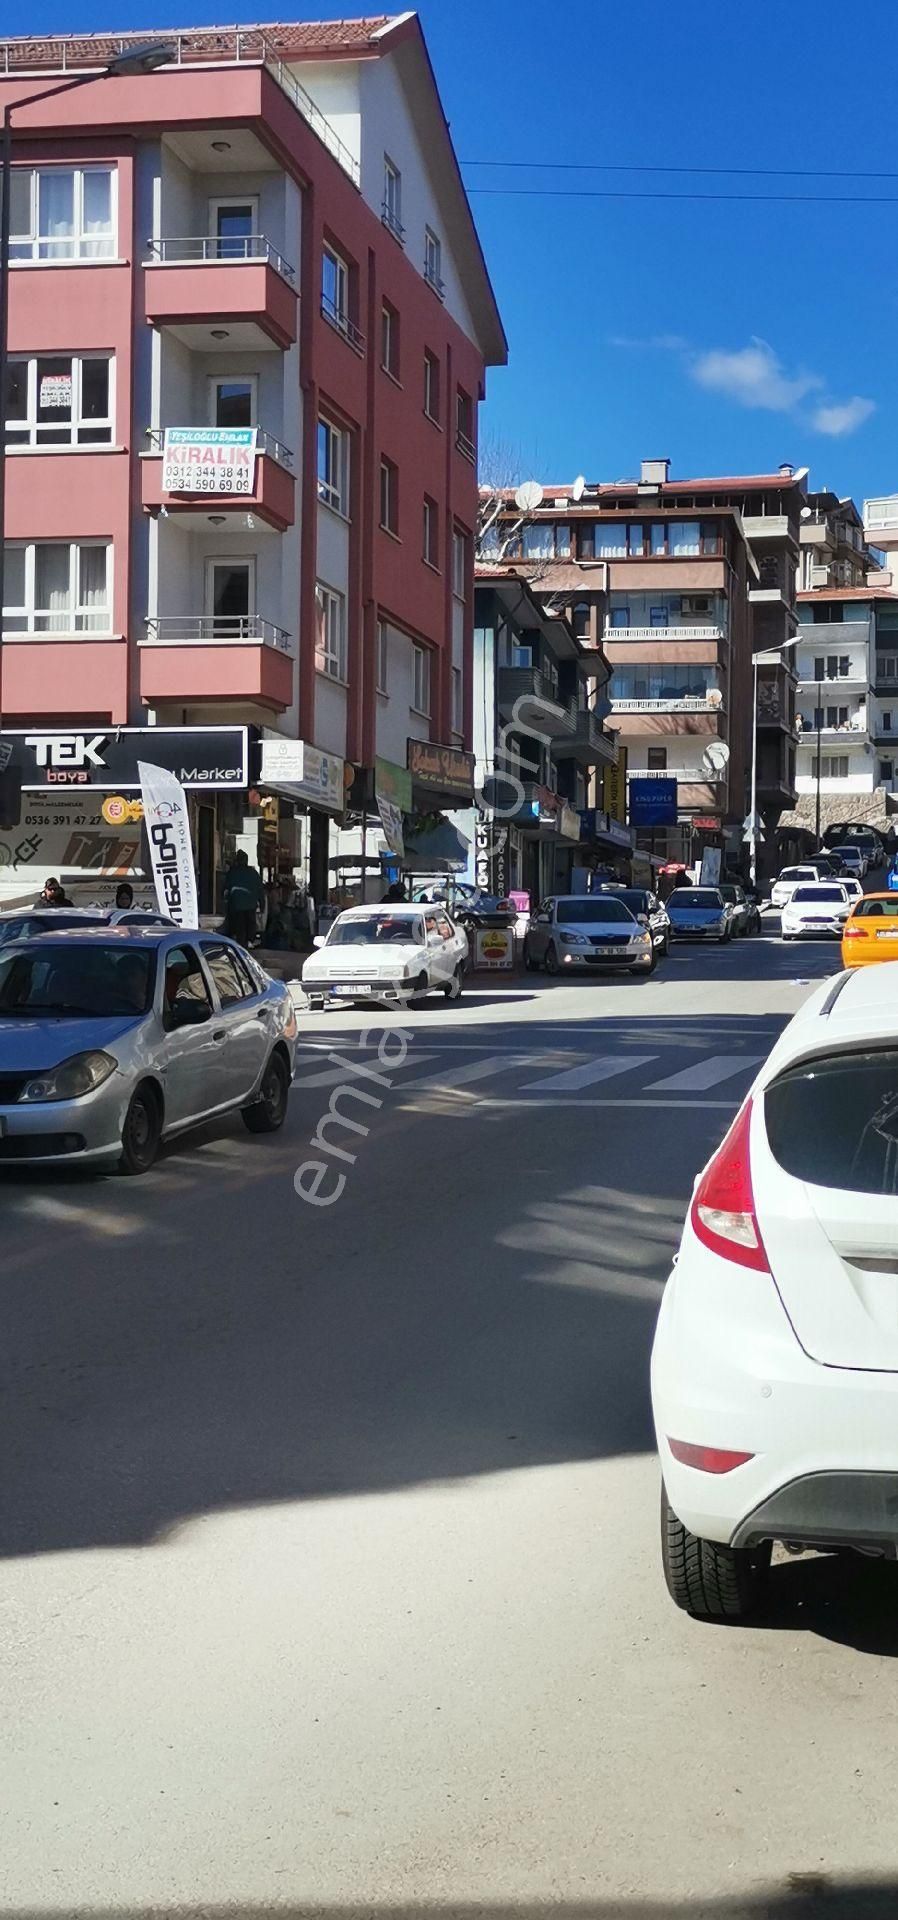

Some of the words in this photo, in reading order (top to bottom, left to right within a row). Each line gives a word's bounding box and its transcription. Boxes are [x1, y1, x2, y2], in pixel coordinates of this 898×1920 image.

[166, 466, 192, 477] 0312
[196, 467, 216, 477] 344
[220, 467, 233, 478] 38
[236, 468, 249, 478] 41
[165, 479, 191, 489] 0534
[195, 479, 215, 490] 590
[219, 480, 233, 491] 69
[236, 480, 249, 491] 09
[25, 736, 107, 766] TEK
[47, 769, 89, 783] boya
[180, 767, 243, 780] Market
[25, 816, 50, 826] 0536
[52, 816, 71, 826] 391
[74, 816, 86, 826] 47
[89, 816, 102, 826] 27
